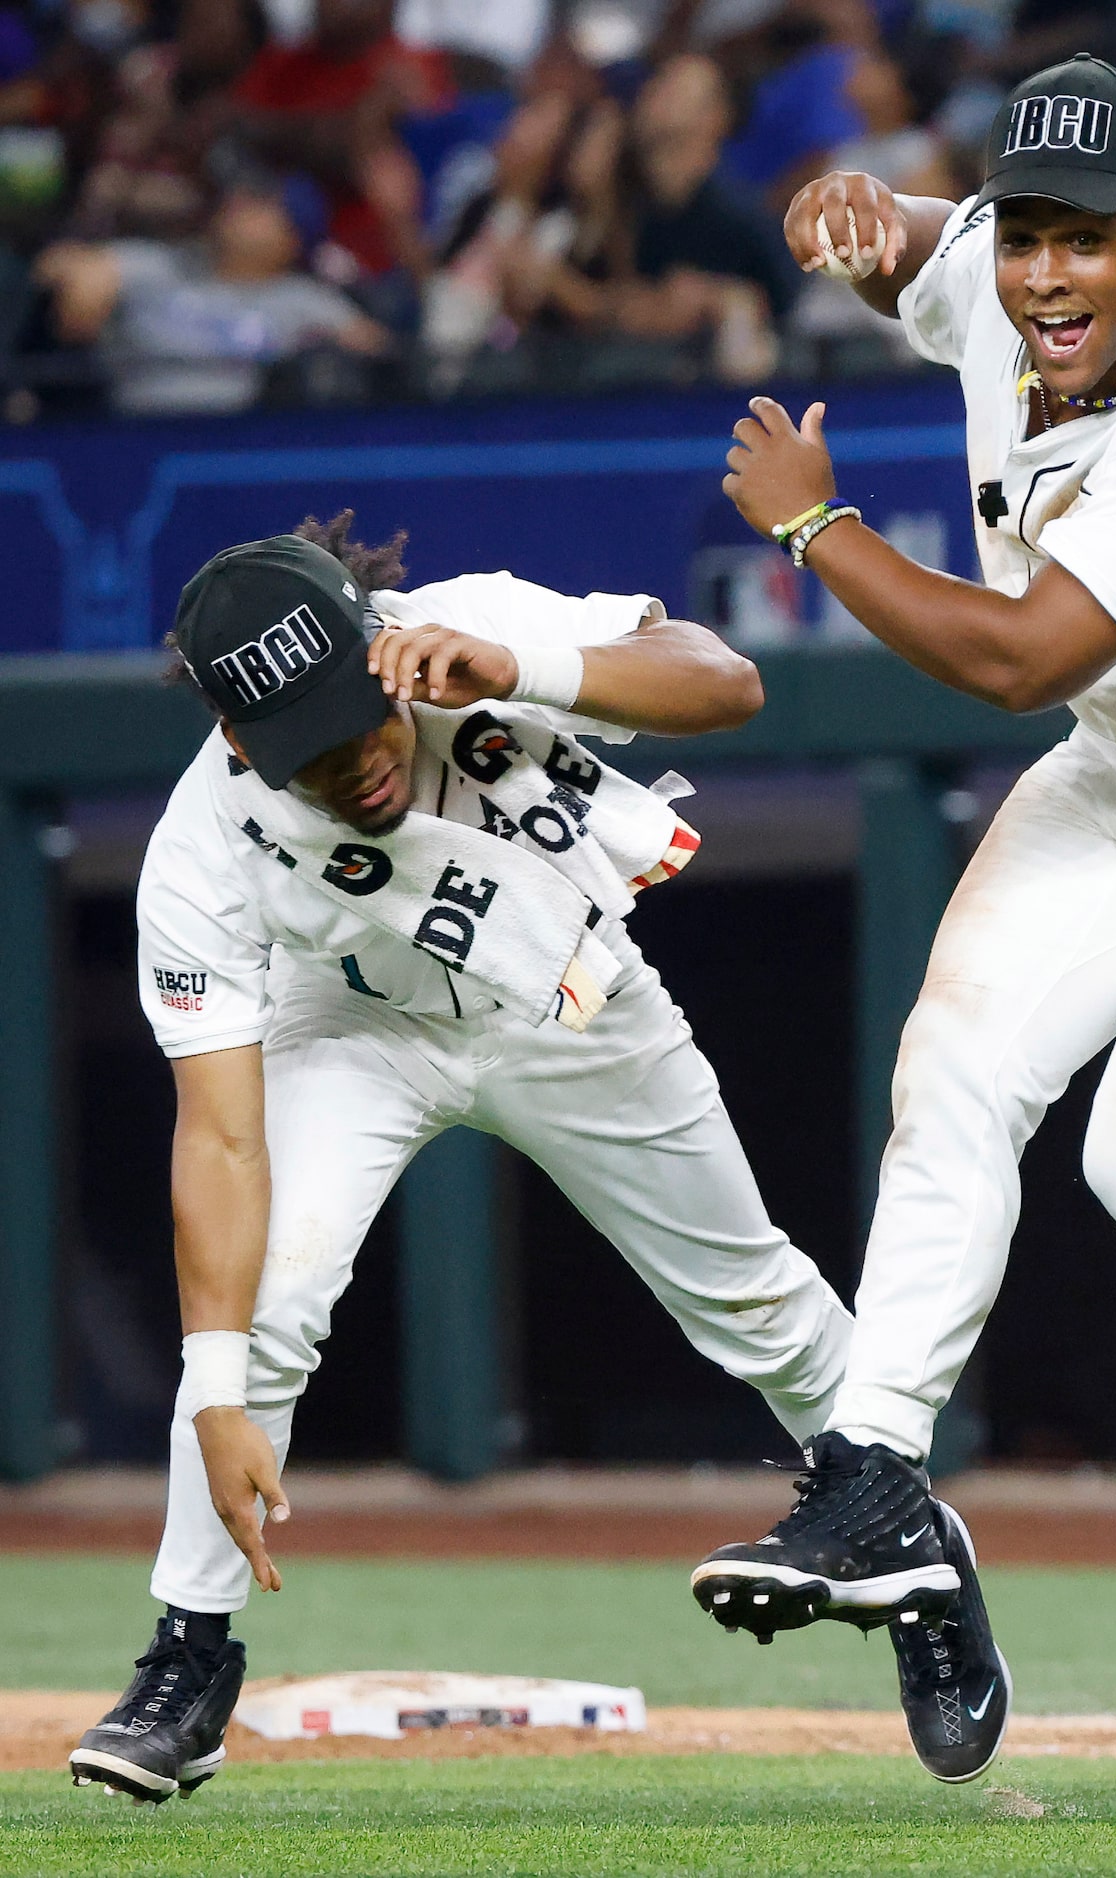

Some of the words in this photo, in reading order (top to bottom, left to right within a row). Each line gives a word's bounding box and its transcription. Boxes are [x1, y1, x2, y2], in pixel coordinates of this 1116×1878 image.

[999, 94, 1113, 158] HBCU
[210, 603, 333, 708] HBCU
[153, 967, 207, 995] HBCU
[160, 993, 204, 1012] CLASSIC
[803, 1446, 817, 1469] NIKE
